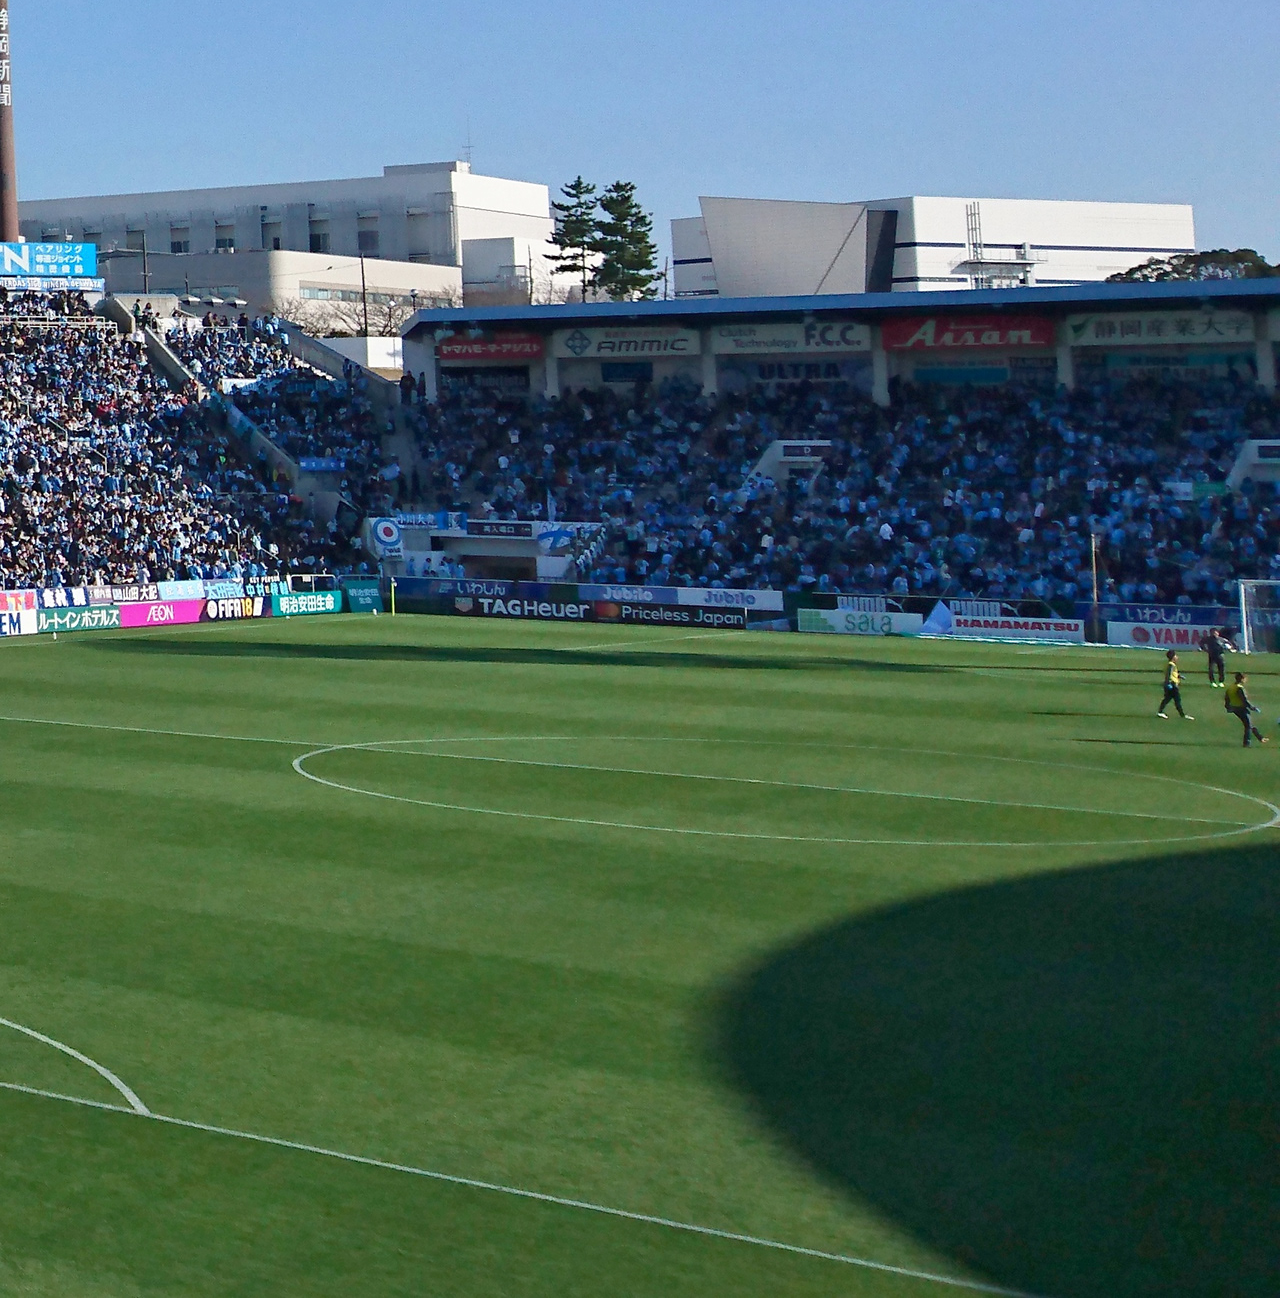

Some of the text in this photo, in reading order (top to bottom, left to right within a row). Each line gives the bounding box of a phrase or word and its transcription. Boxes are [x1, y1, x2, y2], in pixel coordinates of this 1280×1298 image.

[35, 245, 83, 253] ベアリング
[719, 326, 757, 338] Clutch
[804, 320, 863, 347] F.C.C.
[1094, 315, 1253, 339] 静岡産業大学
[596, 339, 688, 353] AMMIC
[732, 338, 798, 349] Technology
[457, 582, 506, 595] いわしん
[279, 594, 335, 614] 明治安田生命
[693, 609, 744, 627] Japan
[1125, 607, 1192, 625] いわしん
[955, 618, 1080, 633] HAMAMATSU
[1152, 628, 1208, 646] YAMA
